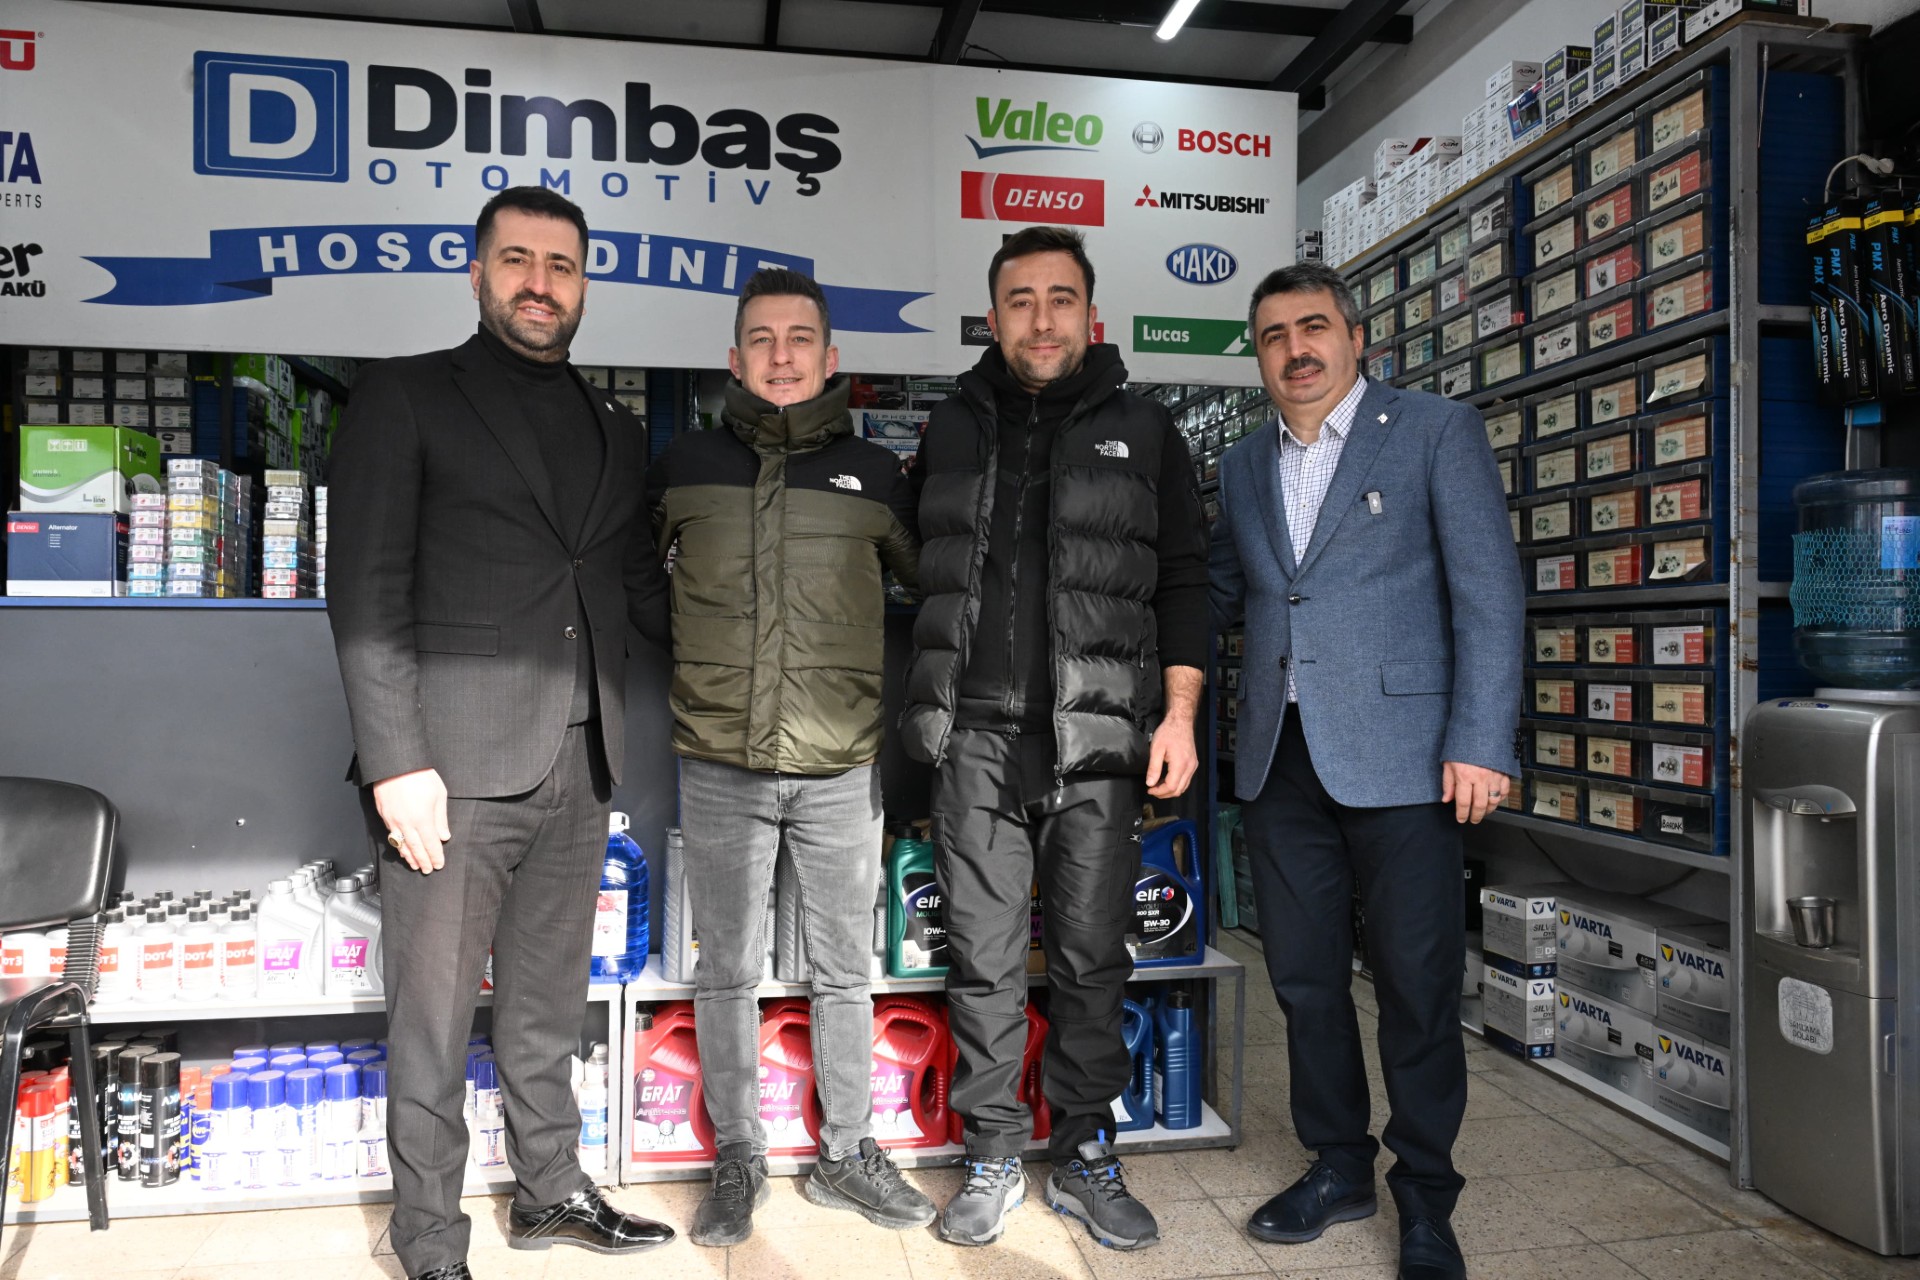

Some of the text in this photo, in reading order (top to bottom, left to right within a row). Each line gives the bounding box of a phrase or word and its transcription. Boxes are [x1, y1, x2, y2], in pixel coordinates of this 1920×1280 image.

[1596, 22, 1615, 40] NIKEN
[1654, 20, 1676, 38] NIKEN
[1572, 49, 1592, 59] NIKE
[1622, 41, 1642, 60] NIKEN
[229, 73, 317, 160] D
[975, 96, 1104, 147] Valeo
[367, 64, 842, 197] Dimbaş
[1177, 128, 1272, 158] BOSCH
[367, 157, 772, 206] OTOMOTİV
[0, 193, 42, 209] ERTS
[1004, 187, 1085, 211] DENSO
[1159, 191, 1266, 215] MITSUBISHI
[1171, 247, 1232, 283] MAKO
[1829, 247, 1842, 277] PMX
[1871, 241, 1884, 272] PMX
[1813, 255, 1825, 285] PMX
[0, 279, 46, 298] AKÜ
[1879, 293, 1888, 322] Aero
[1142, 324, 1190, 343] Lucas
[1820, 305, 1831, 385] Aero Dynamic
[1838, 298, 1851, 379] Aero Dynamic
[1882, 323, 1895, 375] Dynamic
[1094, 443, 1118, 451] NORTH
[1100, 449, 1117, 457] FACE
[48, 524, 79, 532] Alternator
[915, 895, 942, 909] elf
[1135, 888, 1161, 902] elf
[1496, 896, 1517, 910] VARTA
[1143, 919, 1171, 928] 5W-30
[1573, 913, 1613, 940] VARTA
[333, 944, 363, 960] GRAT
[1675, 948, 1725, 980] VARTA
[1497, 973, 1518, 989] VARTA
[1571, 997, 1612, 1027] VARTA
[1674, 1041, 1725, 1077] VARTA
[641, 1081, 685, 1105] GRAT
